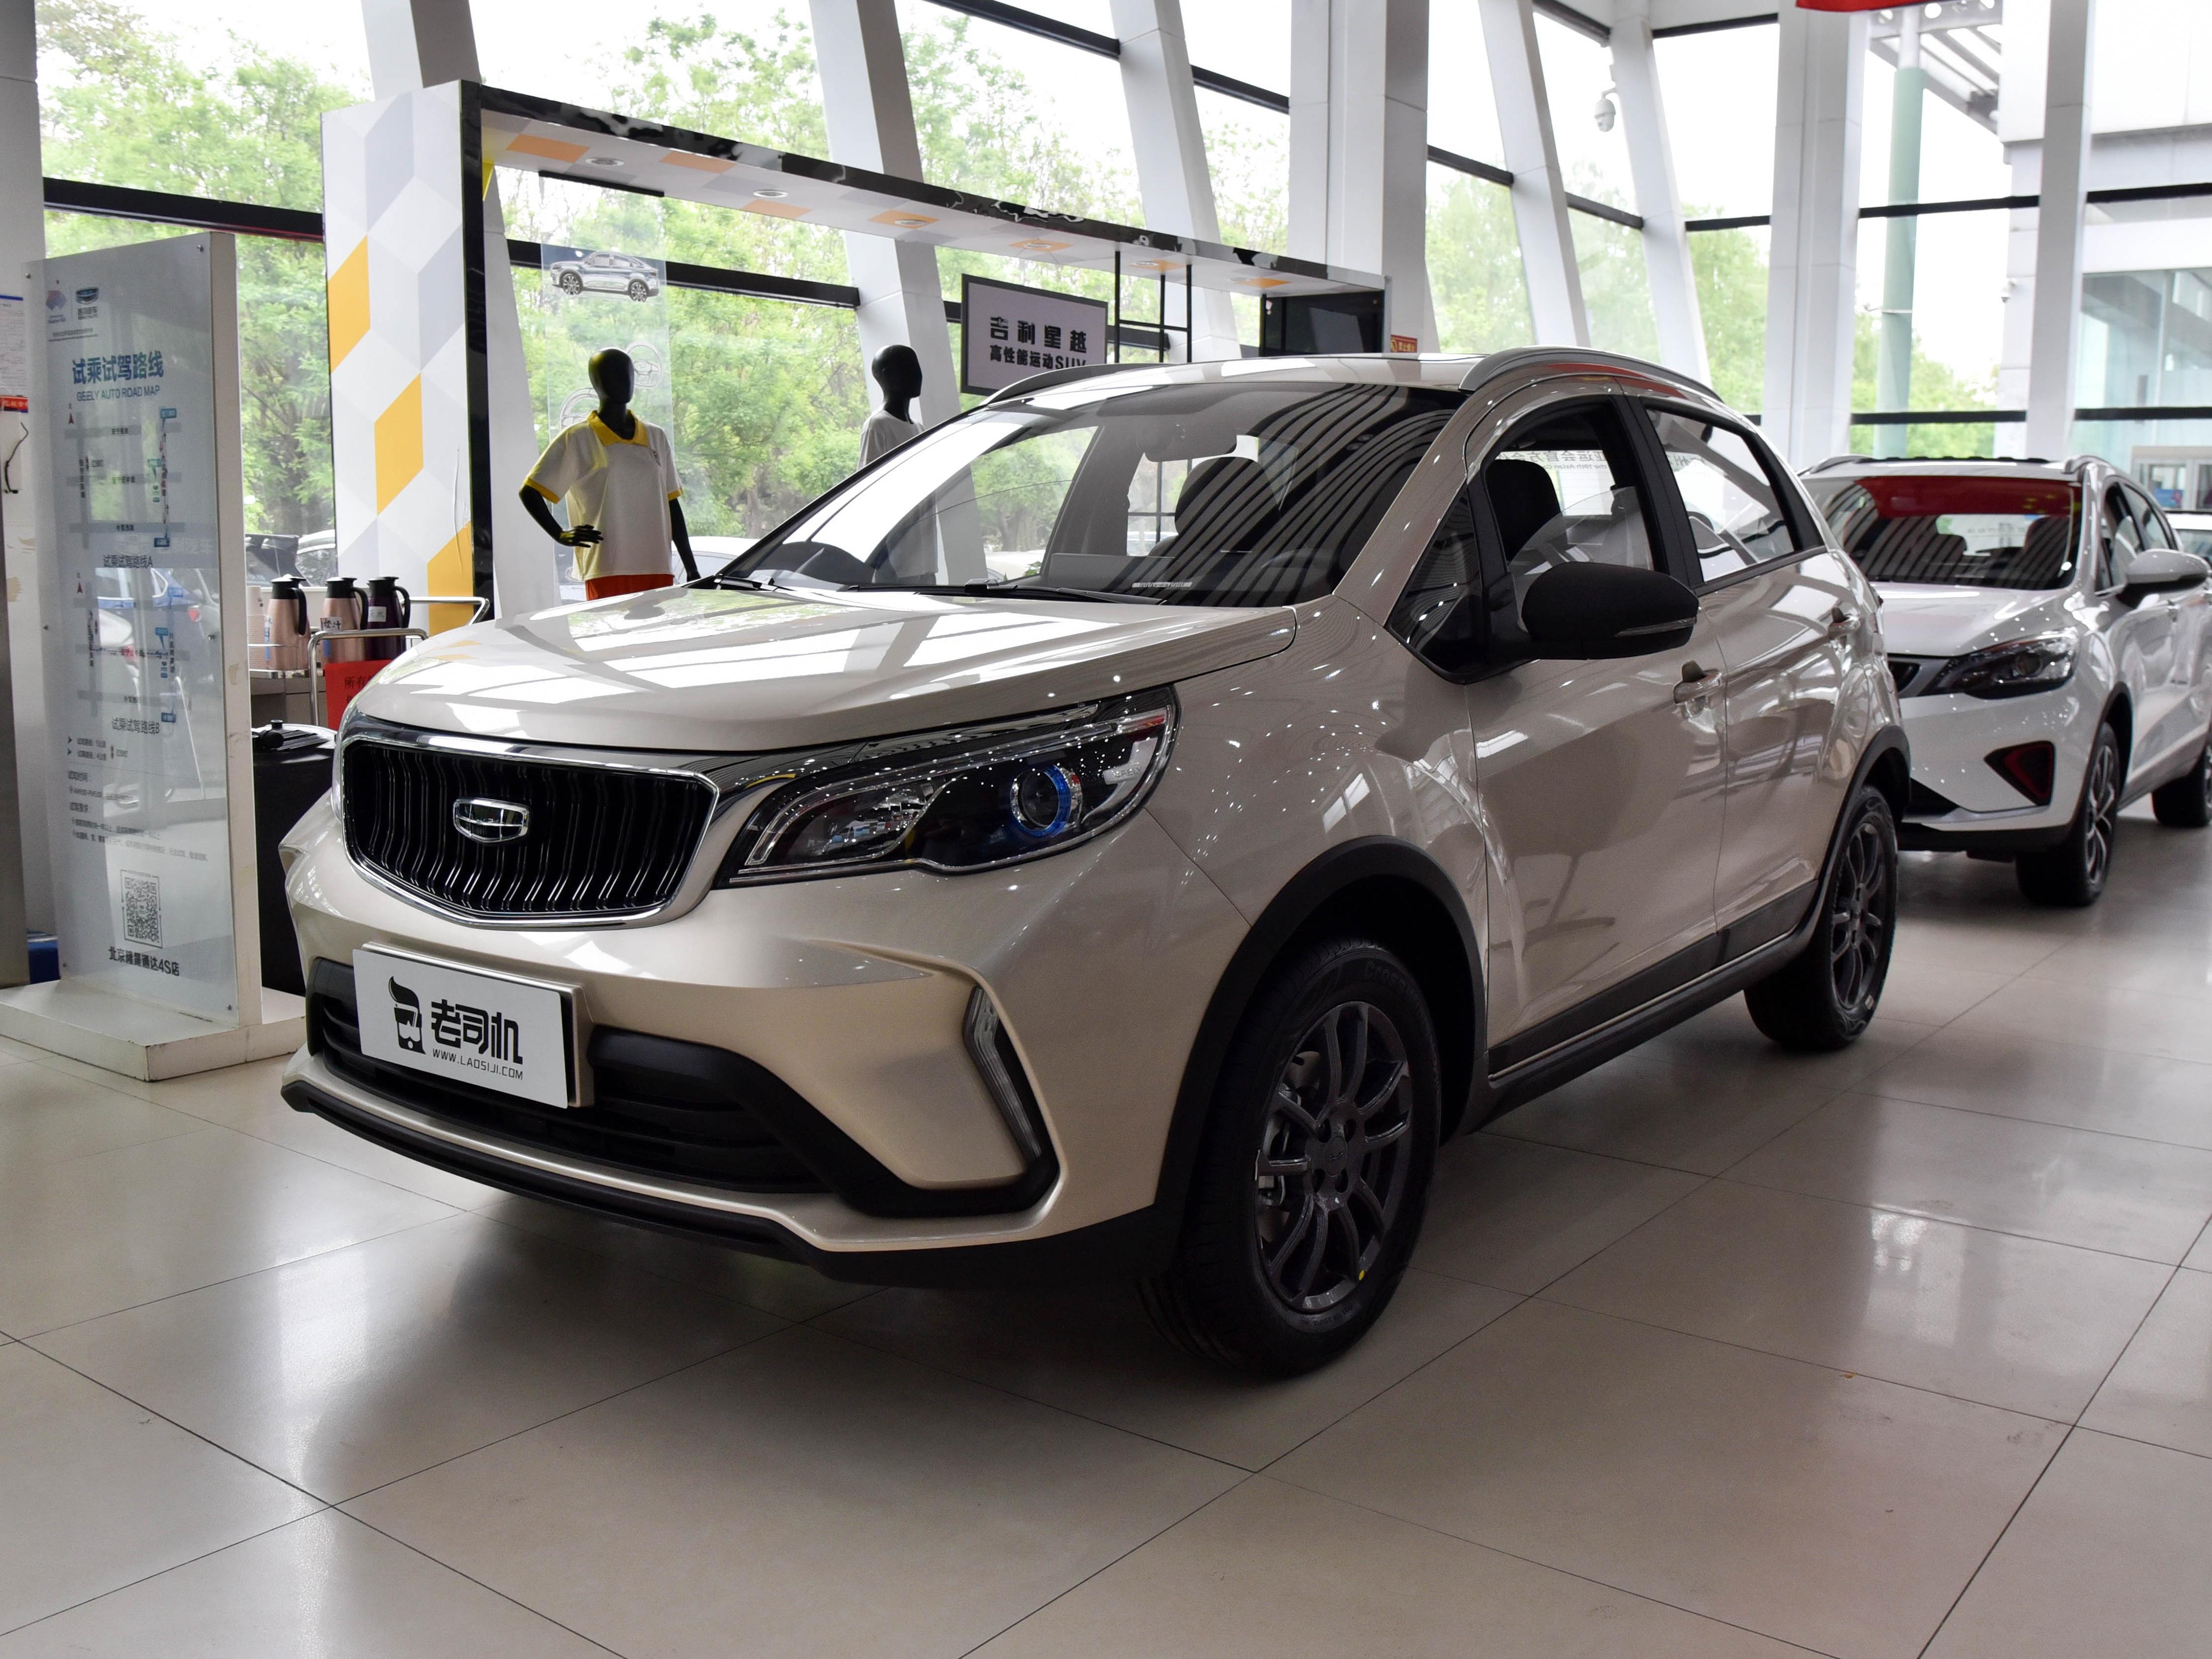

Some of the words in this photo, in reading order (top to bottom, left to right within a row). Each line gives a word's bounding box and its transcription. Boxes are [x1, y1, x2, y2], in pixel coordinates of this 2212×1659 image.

[989, 316, 1087, 353] 吉利星越
[72, 350, 164, 385] 试乘试驾路线
[76, 390, 99, 401] GEELY
[101, 389, 120, 399] AUTO
[121, 387, 143, 398] ROAD
[144, 385, 160, 396] MAP
[431, 998, 523, 1065] 老司机
[432, 1048, 523, 1080] WWW.LAOSIJI.COM
